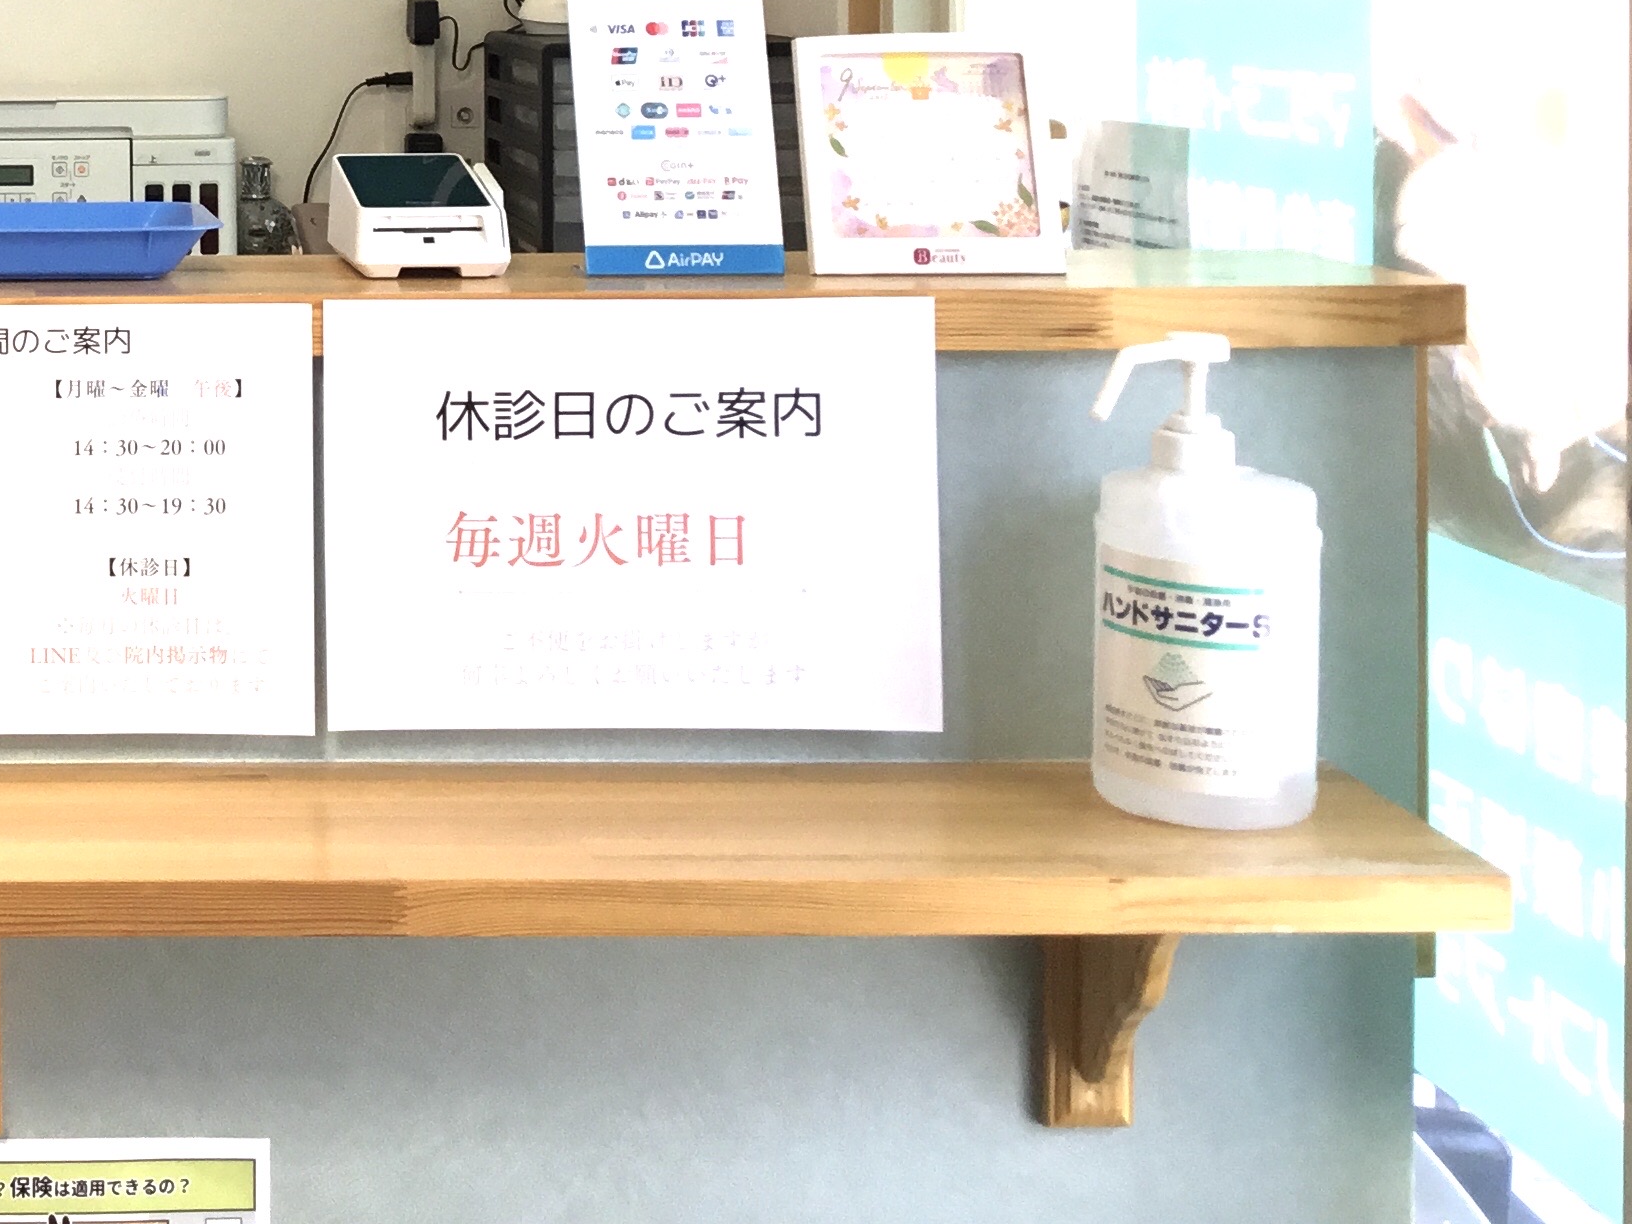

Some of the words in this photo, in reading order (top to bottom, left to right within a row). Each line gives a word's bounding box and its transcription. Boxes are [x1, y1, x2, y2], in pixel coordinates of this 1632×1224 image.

[608, 24, 636, 34] VISA
[667, 252, 724, 267] AirPAY
[436, 387, 822, 441] 休診日のご案内
[445, 511, 746, 568] 毎週火曜日
[108, 557, 191, 578] 【休診日】
[121, 587, 180, 607] 火曜日
[1103, 591, 1270, 638] ハンドサニターS
